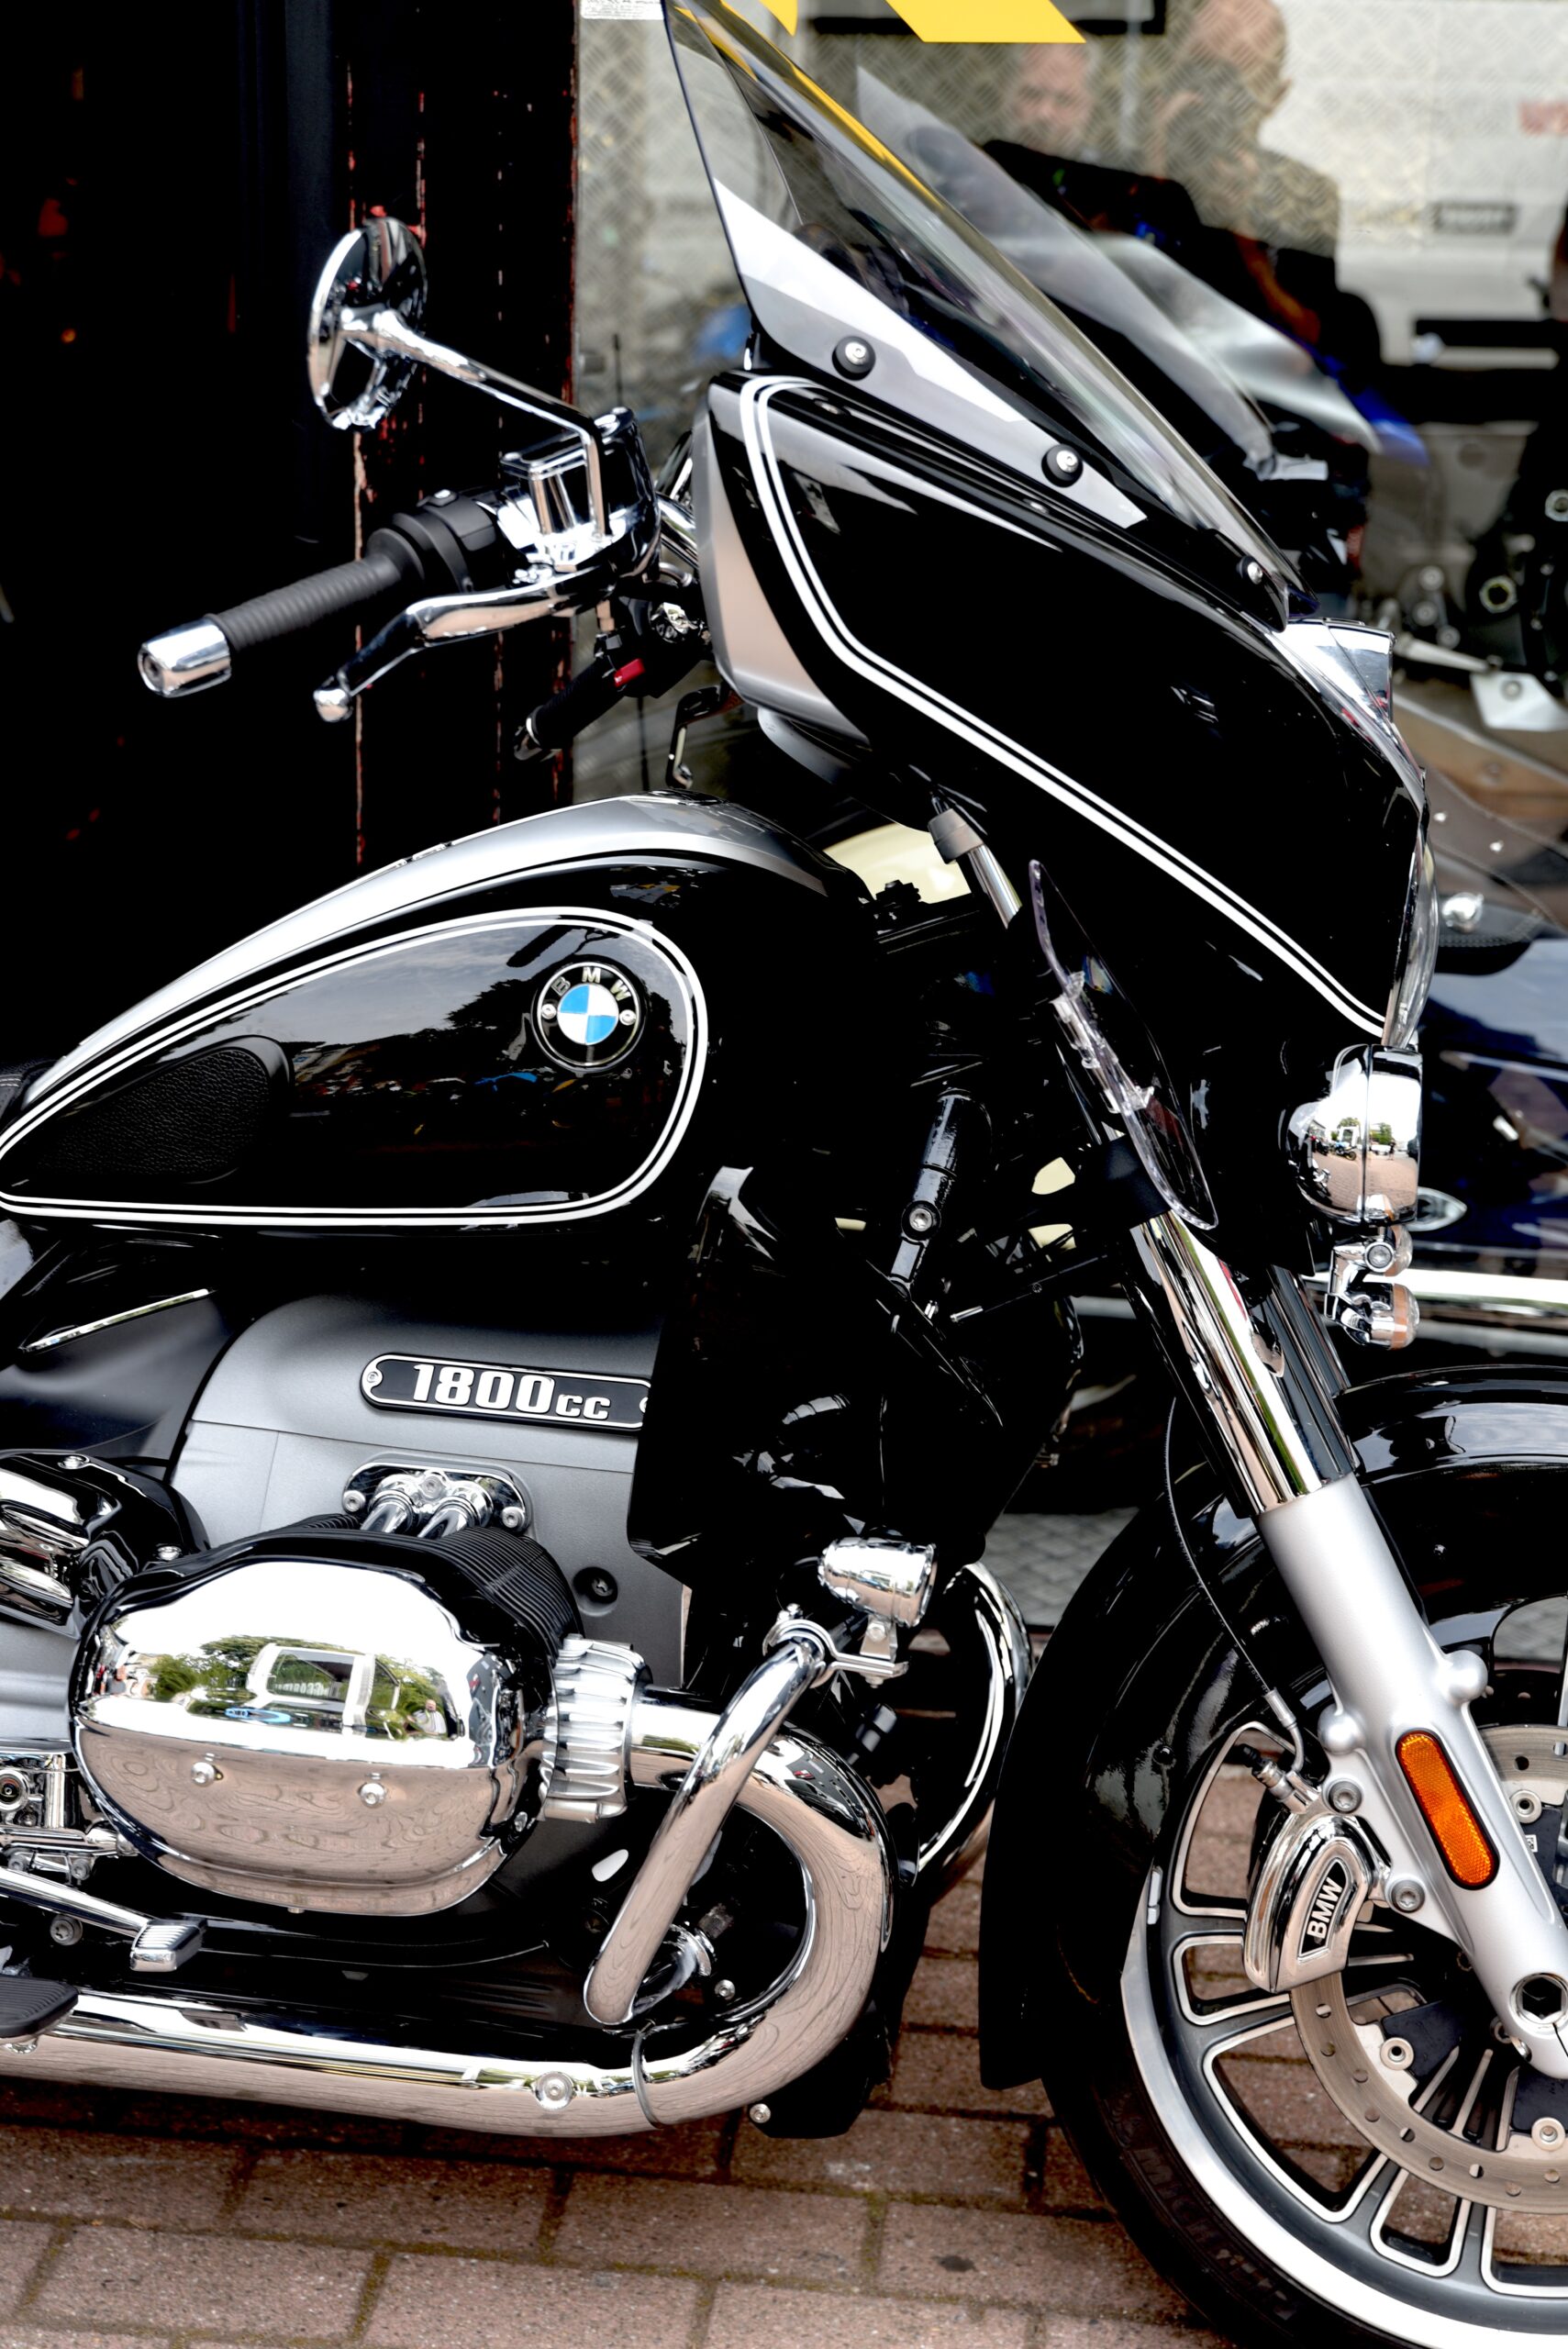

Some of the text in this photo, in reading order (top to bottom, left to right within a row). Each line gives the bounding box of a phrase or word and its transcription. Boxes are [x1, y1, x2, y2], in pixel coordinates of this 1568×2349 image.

[550, 966, 632, 1002] BMW
[413, 1364, 611, 1420] 1800cc
[1307, 1876, 1343, 1939] BMW
